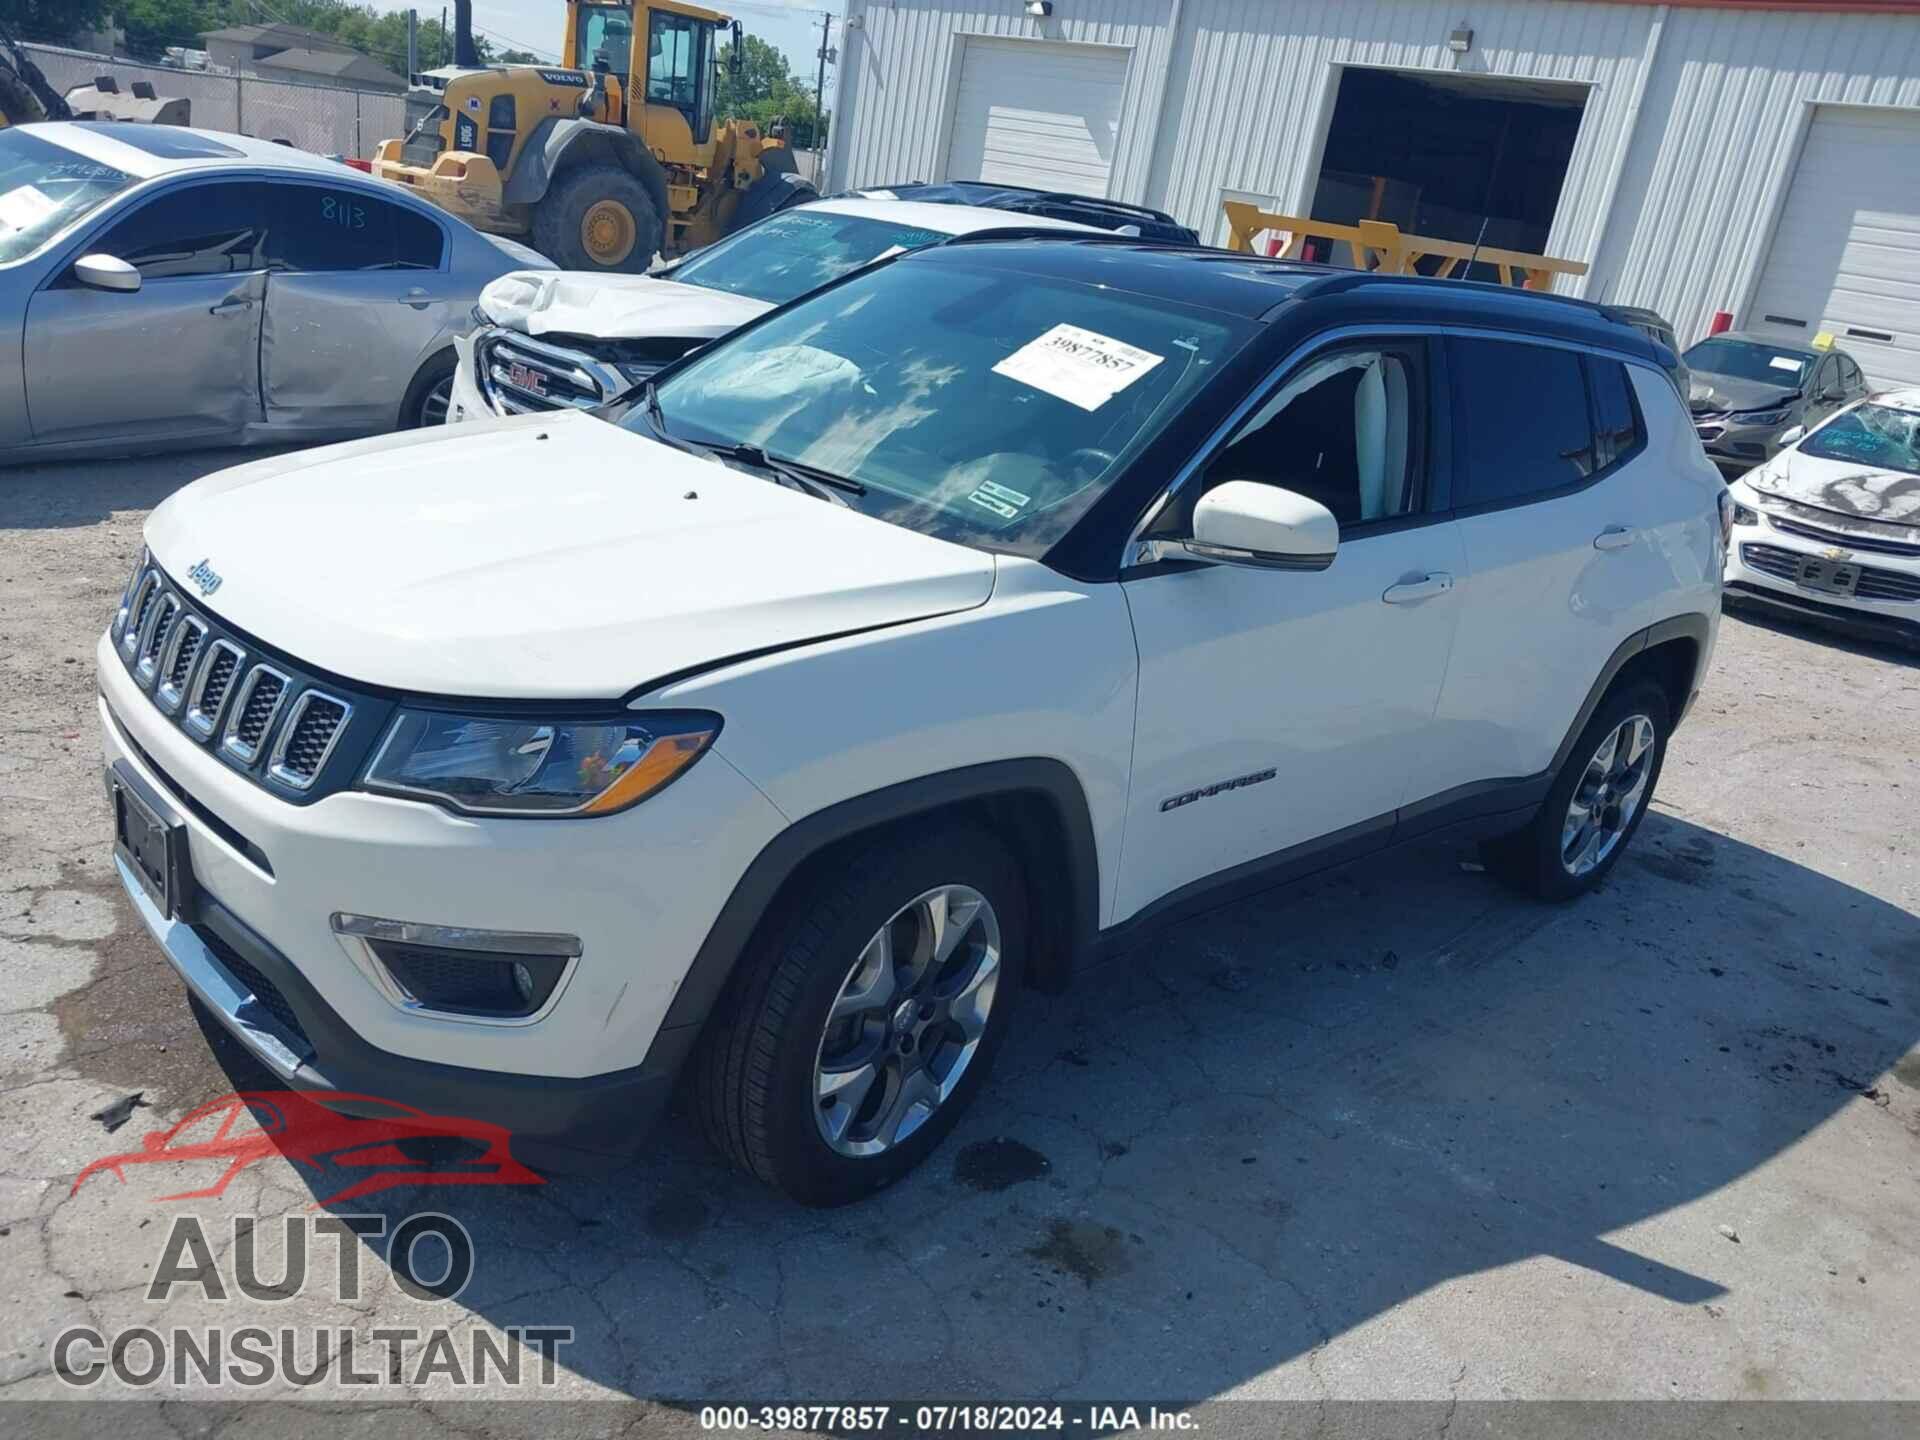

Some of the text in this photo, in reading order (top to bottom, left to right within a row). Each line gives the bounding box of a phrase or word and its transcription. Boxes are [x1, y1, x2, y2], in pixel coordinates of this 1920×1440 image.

[543, 72, 584, 83] VOLVO
[1045, 336, 1136, 372] 39877857
[510, 362, 547, 396] GMC
[187, 558, 223, 597] Jeep
[1160, 767, 1277, 812] COMPASS
